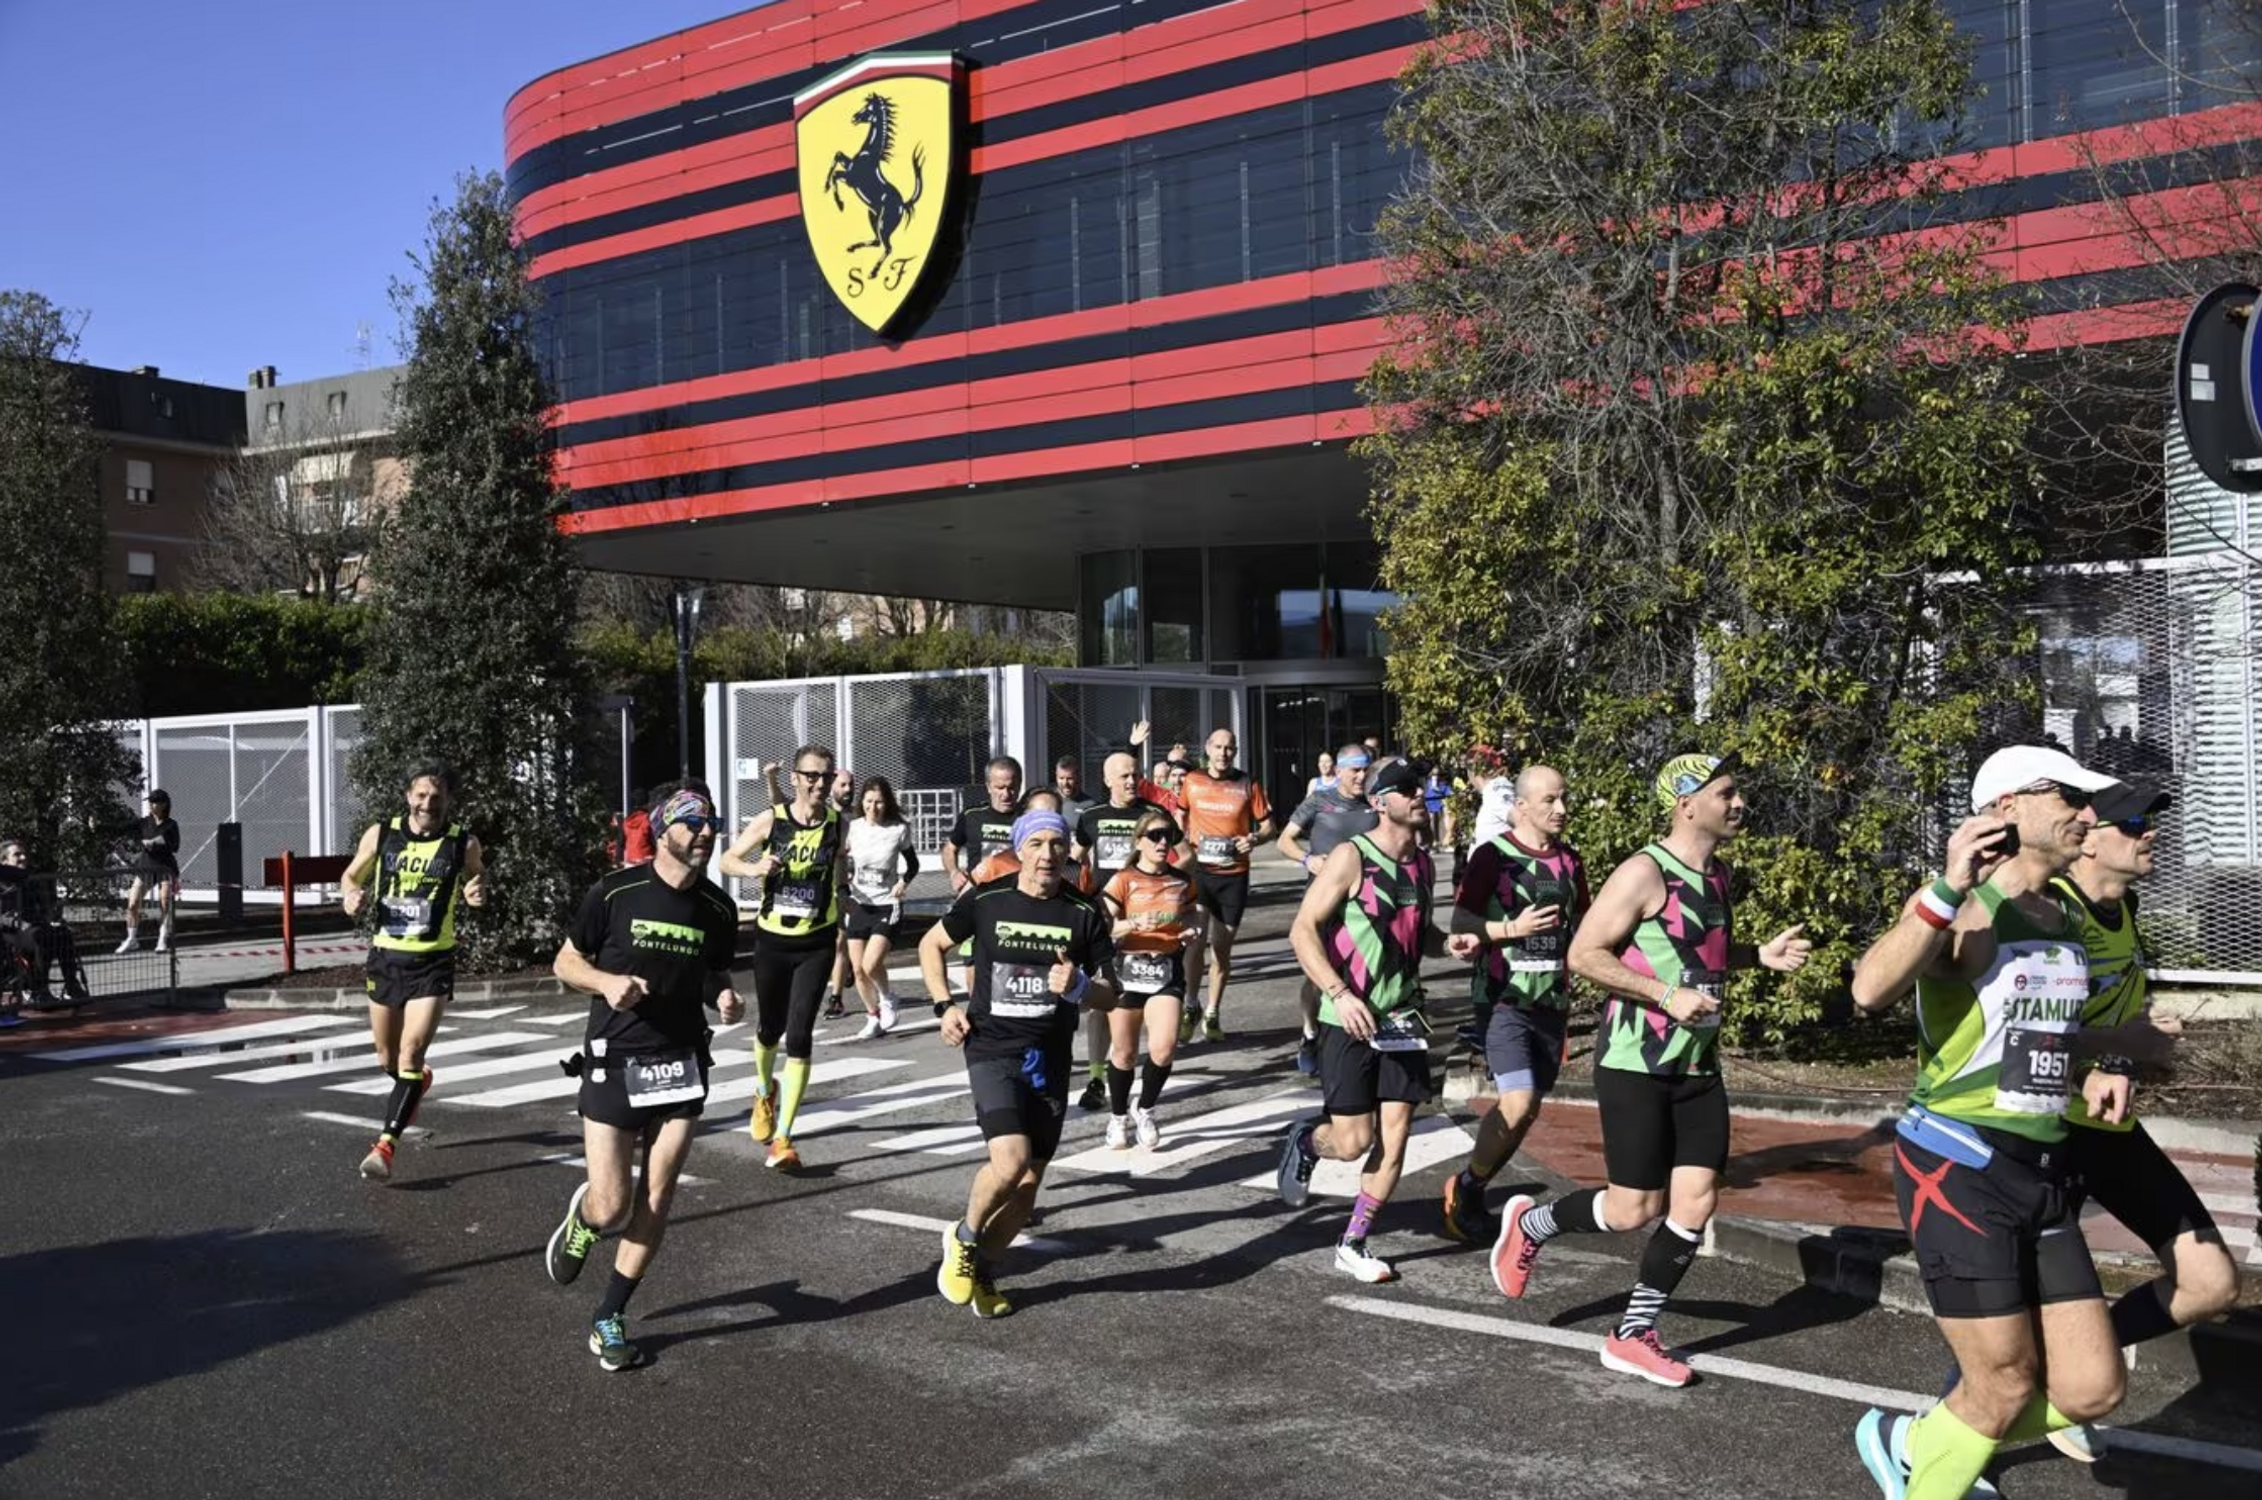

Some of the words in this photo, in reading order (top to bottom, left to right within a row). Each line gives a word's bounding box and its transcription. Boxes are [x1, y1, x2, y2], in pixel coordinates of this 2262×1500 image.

[847, 267, 864, 298] S
[883, 255, 918, 291] F
[632, 939, 700, 956] PONTELUNGO
[998, 940, 1067, 952] PONTELUNGO
[1525, 936, 1557, 950] 1539
[1005, 976, 1043, 993] 4118
[2009, 1035, 2019, 1046] C
[640, 1061, 685, 1081] 4109
[2028, 1049, 2069, 1077] 1951
